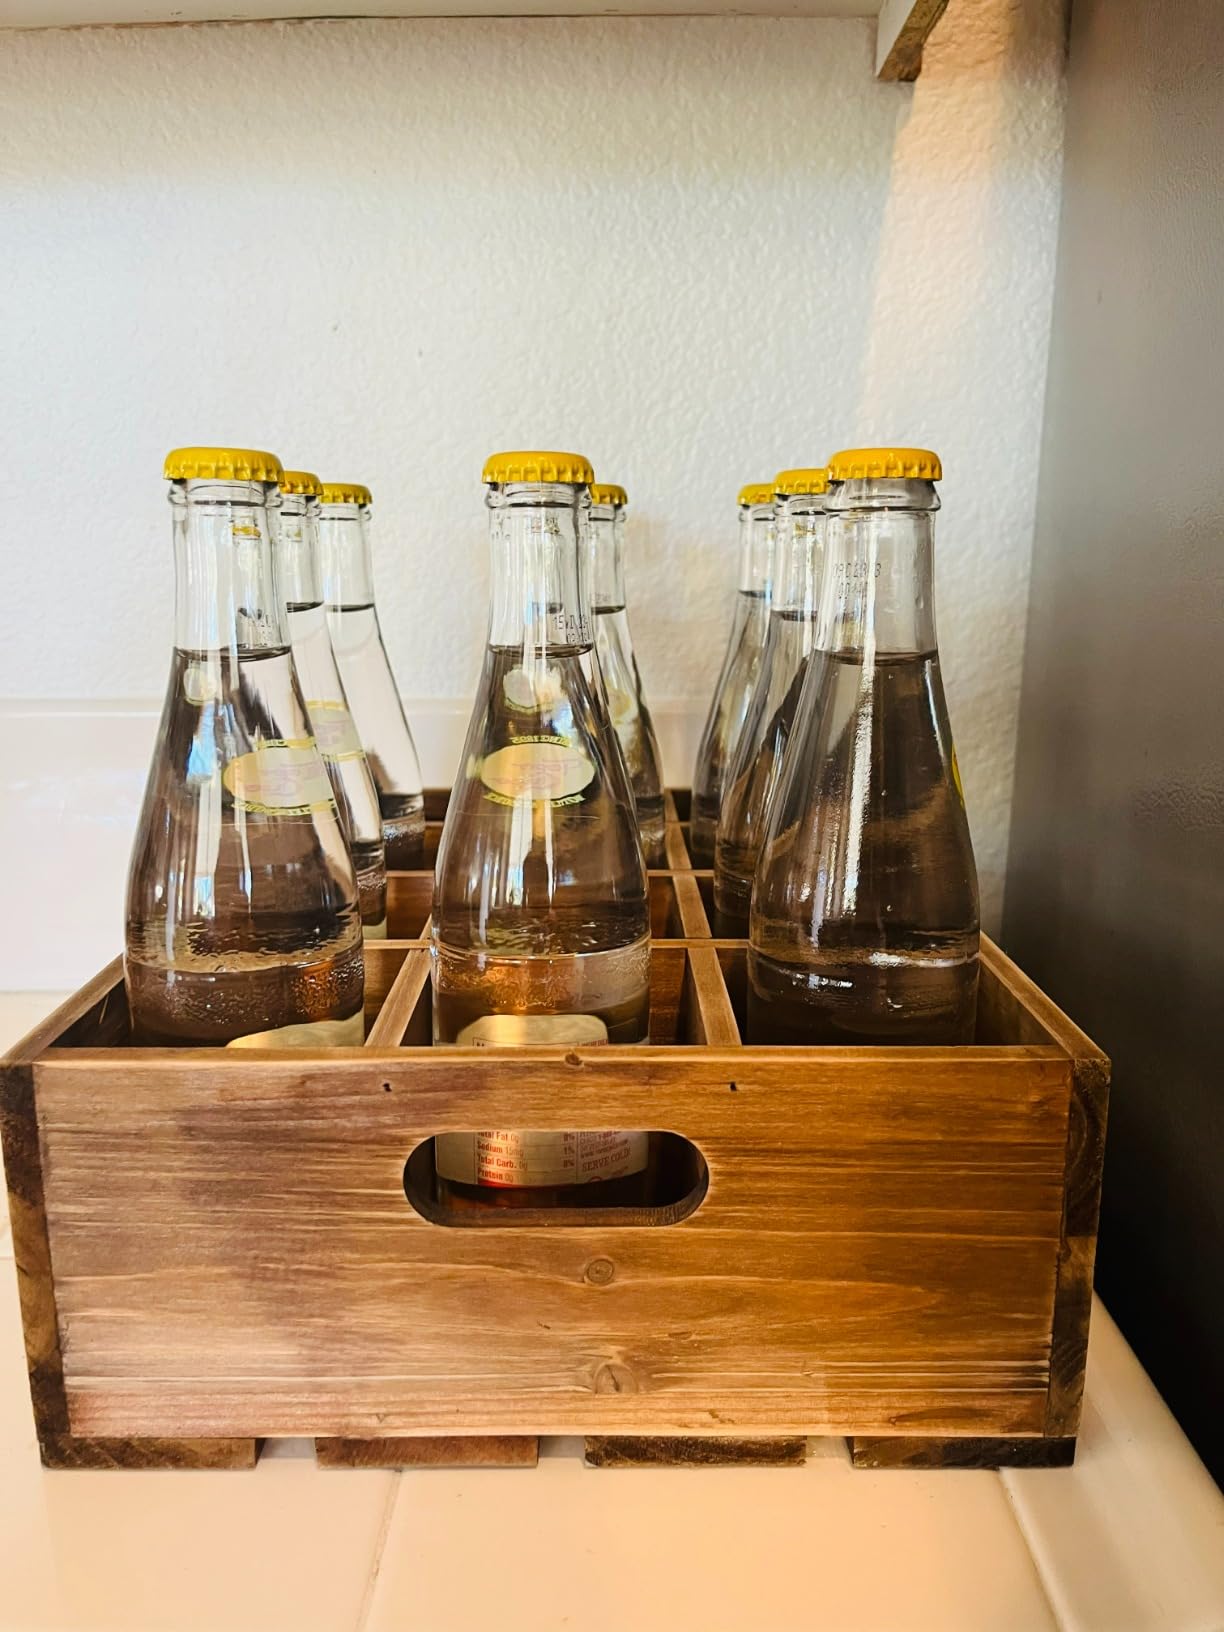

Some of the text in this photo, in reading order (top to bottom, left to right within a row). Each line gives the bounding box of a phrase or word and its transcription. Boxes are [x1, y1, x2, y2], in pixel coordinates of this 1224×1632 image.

[477, 1140, 503, 1153] Sodium
[477, 1153, 495, 1165] Total
[497, 1158, 517, 1169] Carb.
[582, 1157, 609, 1172] SERVE
[478, 1167, 503, 1181] Protein
